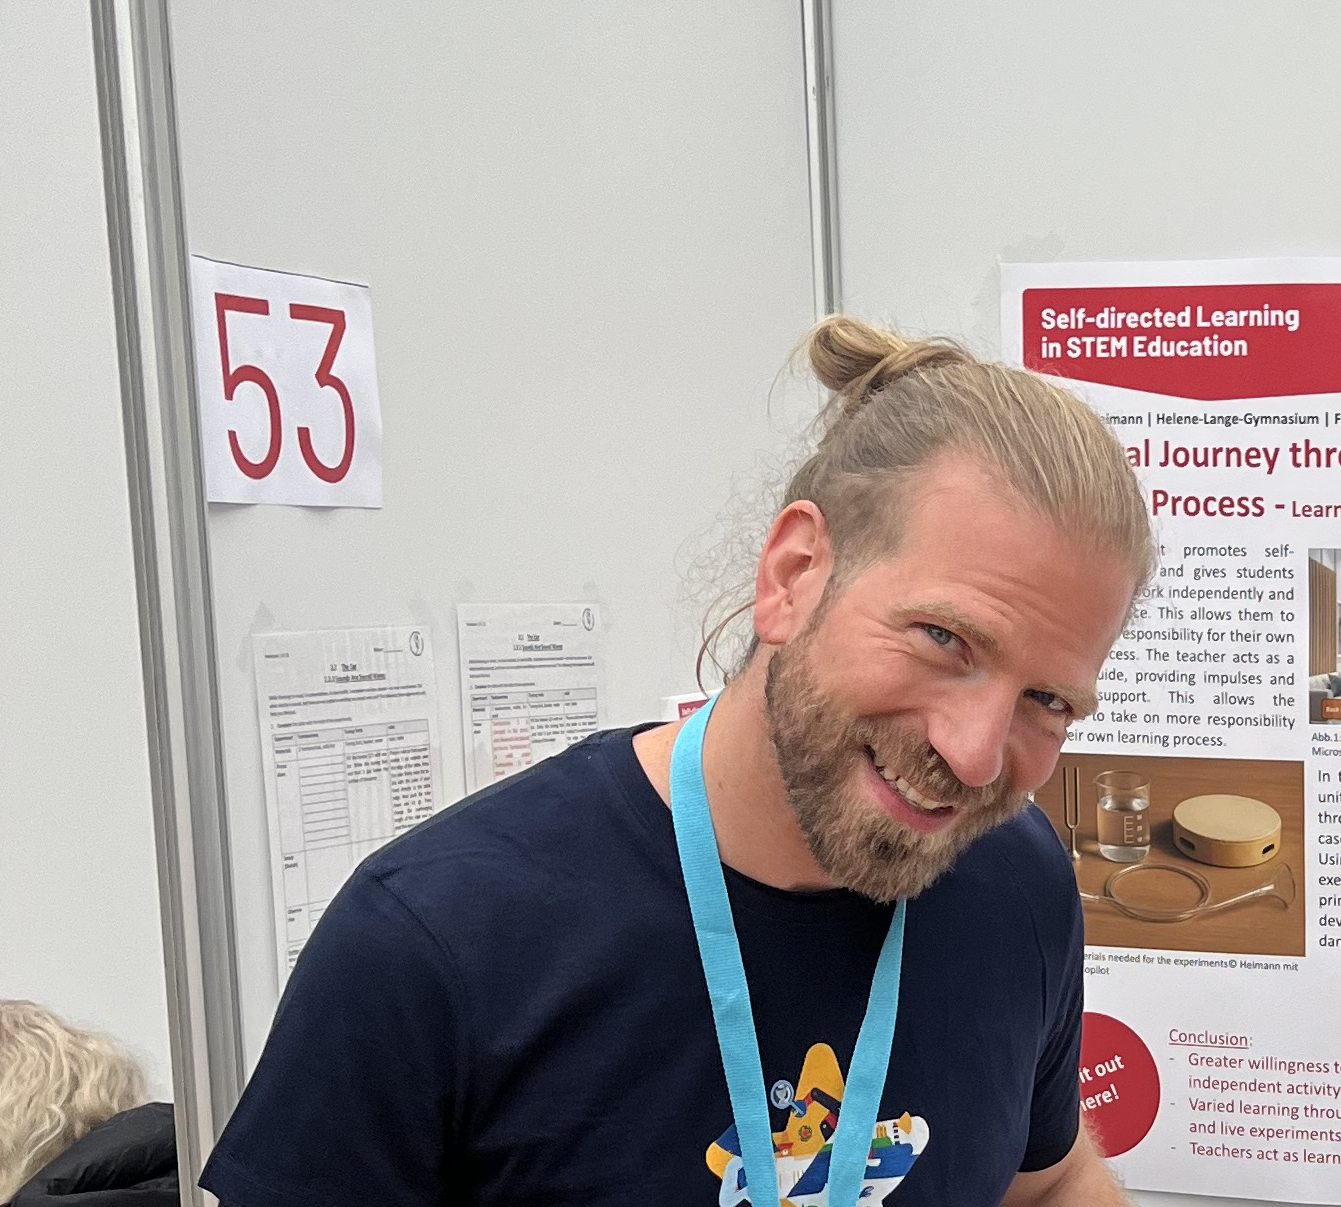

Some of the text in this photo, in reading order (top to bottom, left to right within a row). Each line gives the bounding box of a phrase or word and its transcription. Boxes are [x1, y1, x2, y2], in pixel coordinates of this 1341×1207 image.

[1041, 304, 1300, 332] Self-directed Learning
[1042, 334, 1248, 358] in STEM Education
[214, 292, 357, 484] 53
[1097, 413, 1143, 426] eimann
[1156, 412, 1319, 427] Helene-Lange-Gymnasium
[1159, 440, 1280, 475] Journey
[1152, 489, 1264, 518] Process
[1184, 544, 1294, 558] promotes self-
[1160, 564, 1294, 580] and gives students
[1142, 586, 1294, 602] ork independently and
[1157, 606, 1295, 622] This allows them to
[1122, 628, 1294, 644] esponsibility for their own
[1145, 649, 1294, 664] The teacher acts as a
[1136, 670, 1294, 686] providing impulses and
[1087, 731, 1226, 747] own learning process.
[1318, 770, 1330, 782] In
[1169, 1028, 1252, 1050] Conclusion:
[1095, 1054, 1125, 1078] out
[1188, 1052, 1244, 1068] Greater
[1248, 1056, 1330, 1075] willingness
[1189, 1076, 1282, 1094] independent
[1286, 1082, 1341, 1100] activity
[1188, 1098, 1234, 1113] Varied
[1240, 1100, 1300, 1120] learning
[1189, 1120, 1341, 1142] and live experiments
[1189, 1142, 1252, 1159] Teachers
[1256, 1148, 1278, 1161] act
[1283, 1152, 1298, 1162] as
